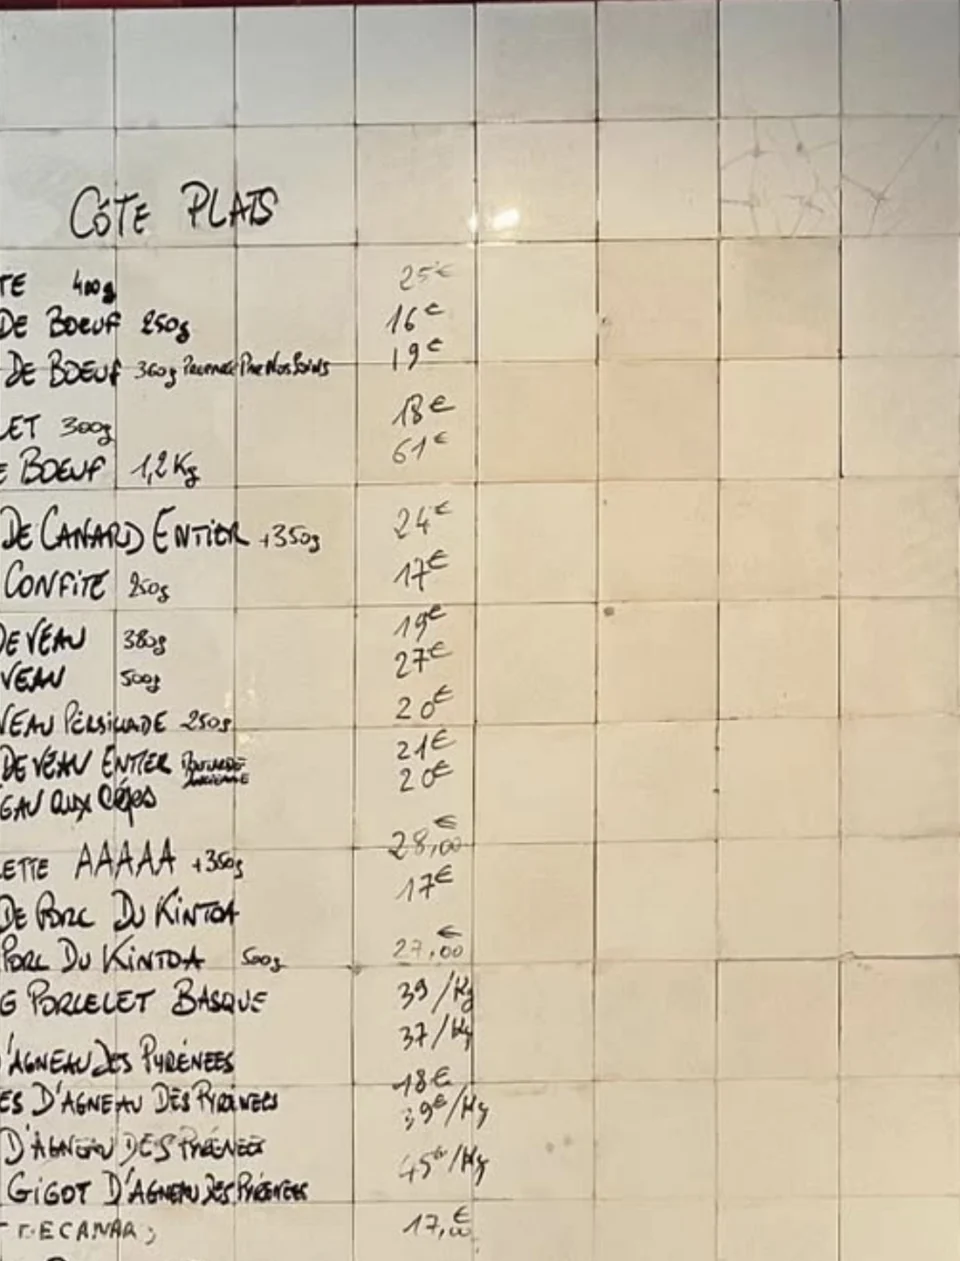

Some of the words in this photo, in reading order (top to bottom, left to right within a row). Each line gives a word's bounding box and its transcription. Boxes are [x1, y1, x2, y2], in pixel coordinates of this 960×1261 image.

[180, 180, 279, 230] PLATS
[386, 302, 446, 335] 16€
[5, 350, 36, 388] DE
[391, 337, 445, 371] 19€
[60, 417, 116, 446] 300g
[0, 504, 33, 552] DE
[41, 504, 145, 556] CANARD
[393, 500, 455, 540] 24€
[393, 548, 449, 593] 17€
[26, 616, 88, 652] VEAU
[393, 602, 448, 643] 19€
[0, 661, 67, 690] VEAU
[393, 639, 455, 679] 27€
[395, 684, 455, 721] 20€
[0, 744, 28, 782] DE
[32, 744, 94, 778] VEAU
[397, 728, 457, 762] 21€
[398, 760, 455, 794] 20€
[74, 837, 177, 880] AAAAA
[396, 864, 455, 903] 17€
[111, 889, 146, 932] DU
[58, 938, 91, 973] DU
